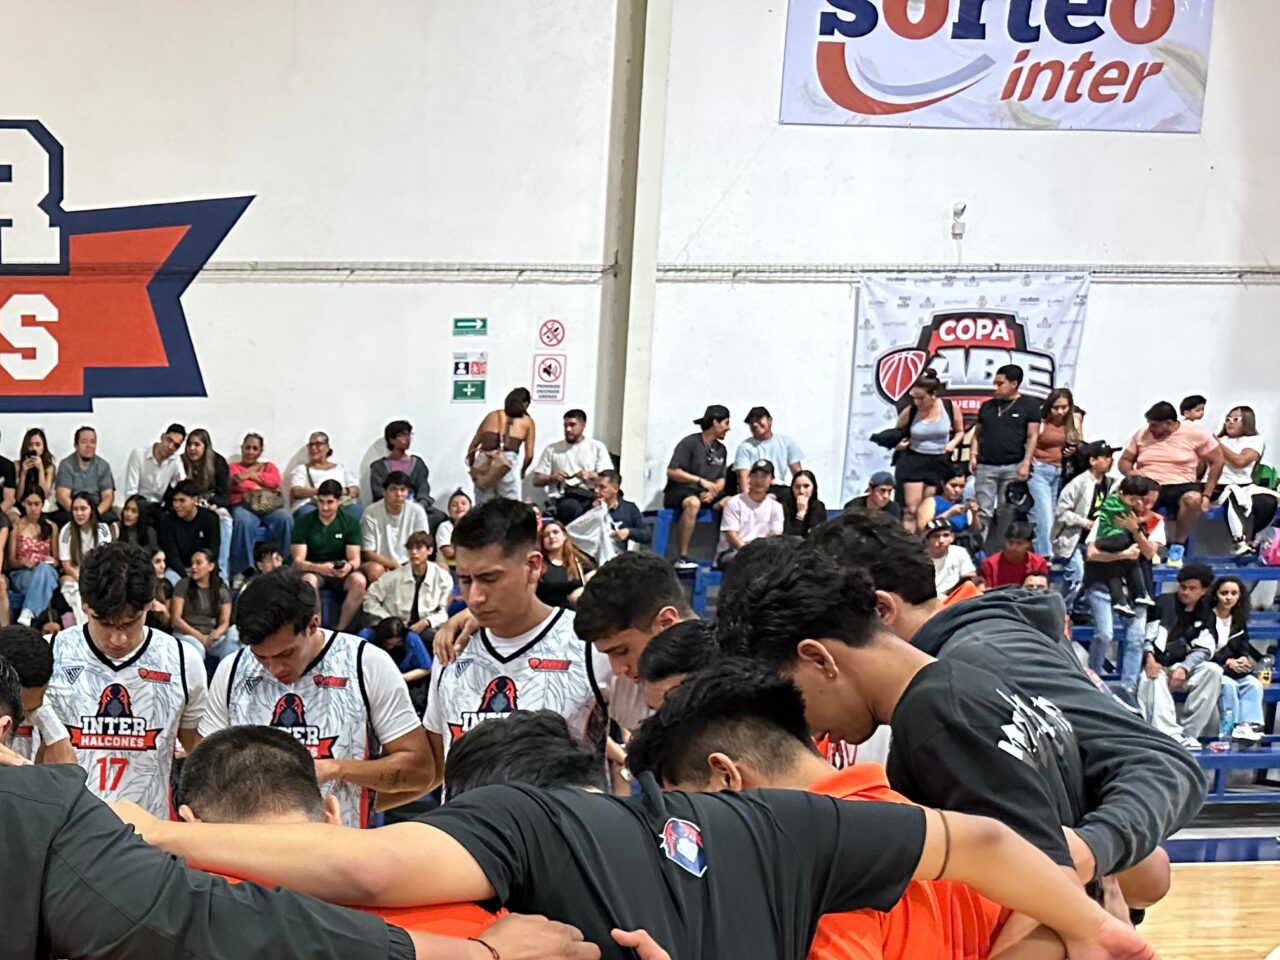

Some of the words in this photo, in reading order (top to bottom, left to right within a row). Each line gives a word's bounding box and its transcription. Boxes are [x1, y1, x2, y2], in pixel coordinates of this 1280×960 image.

[1000, 49, 1164, 103] inter
[938, 318, 1010, 342] COPA
[81, 716, 146, 736] INTER
[81, 736, 145, 748] HALCONES
[96, 757, 129, 792] 17
